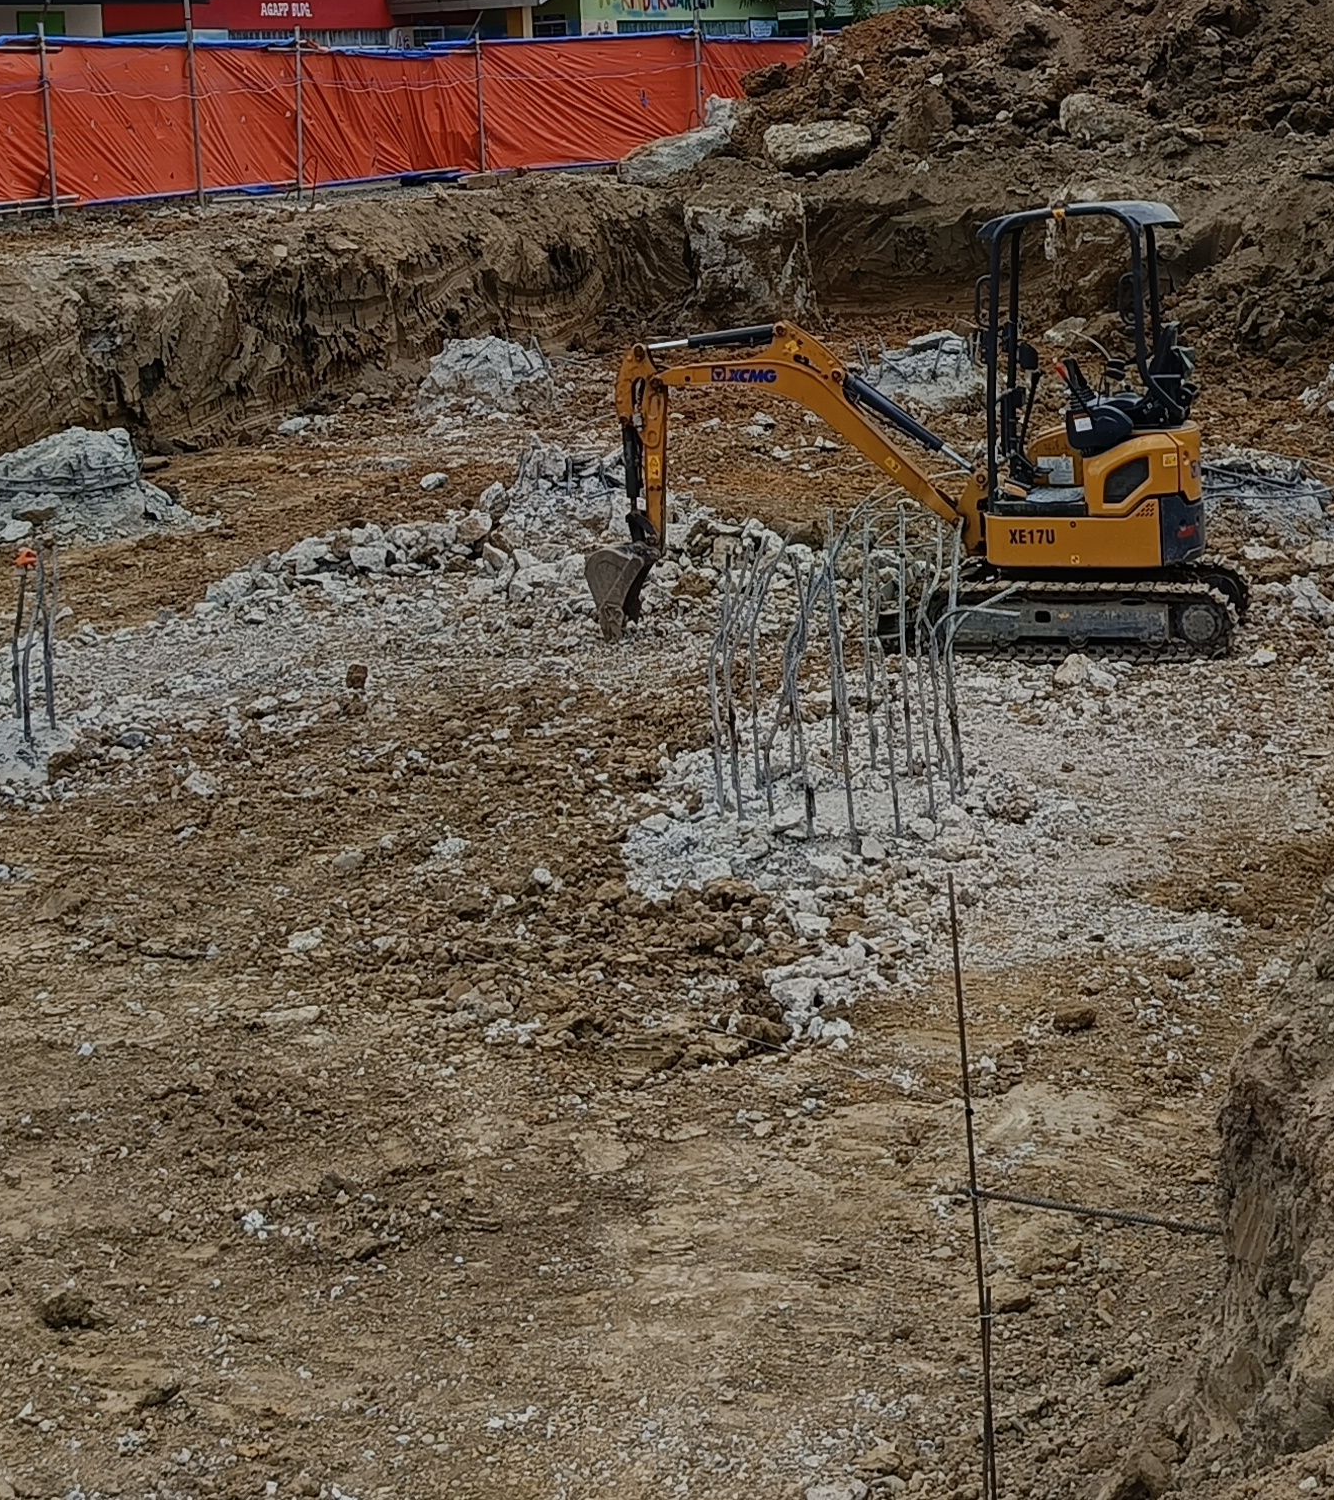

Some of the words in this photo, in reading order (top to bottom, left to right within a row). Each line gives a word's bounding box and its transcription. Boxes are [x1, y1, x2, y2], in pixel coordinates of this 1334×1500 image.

[260, 2, 289, 17] AGAPP
[728, 368, 777, 384] XCMG
[1008, 528, 1056, 545] XE17U
